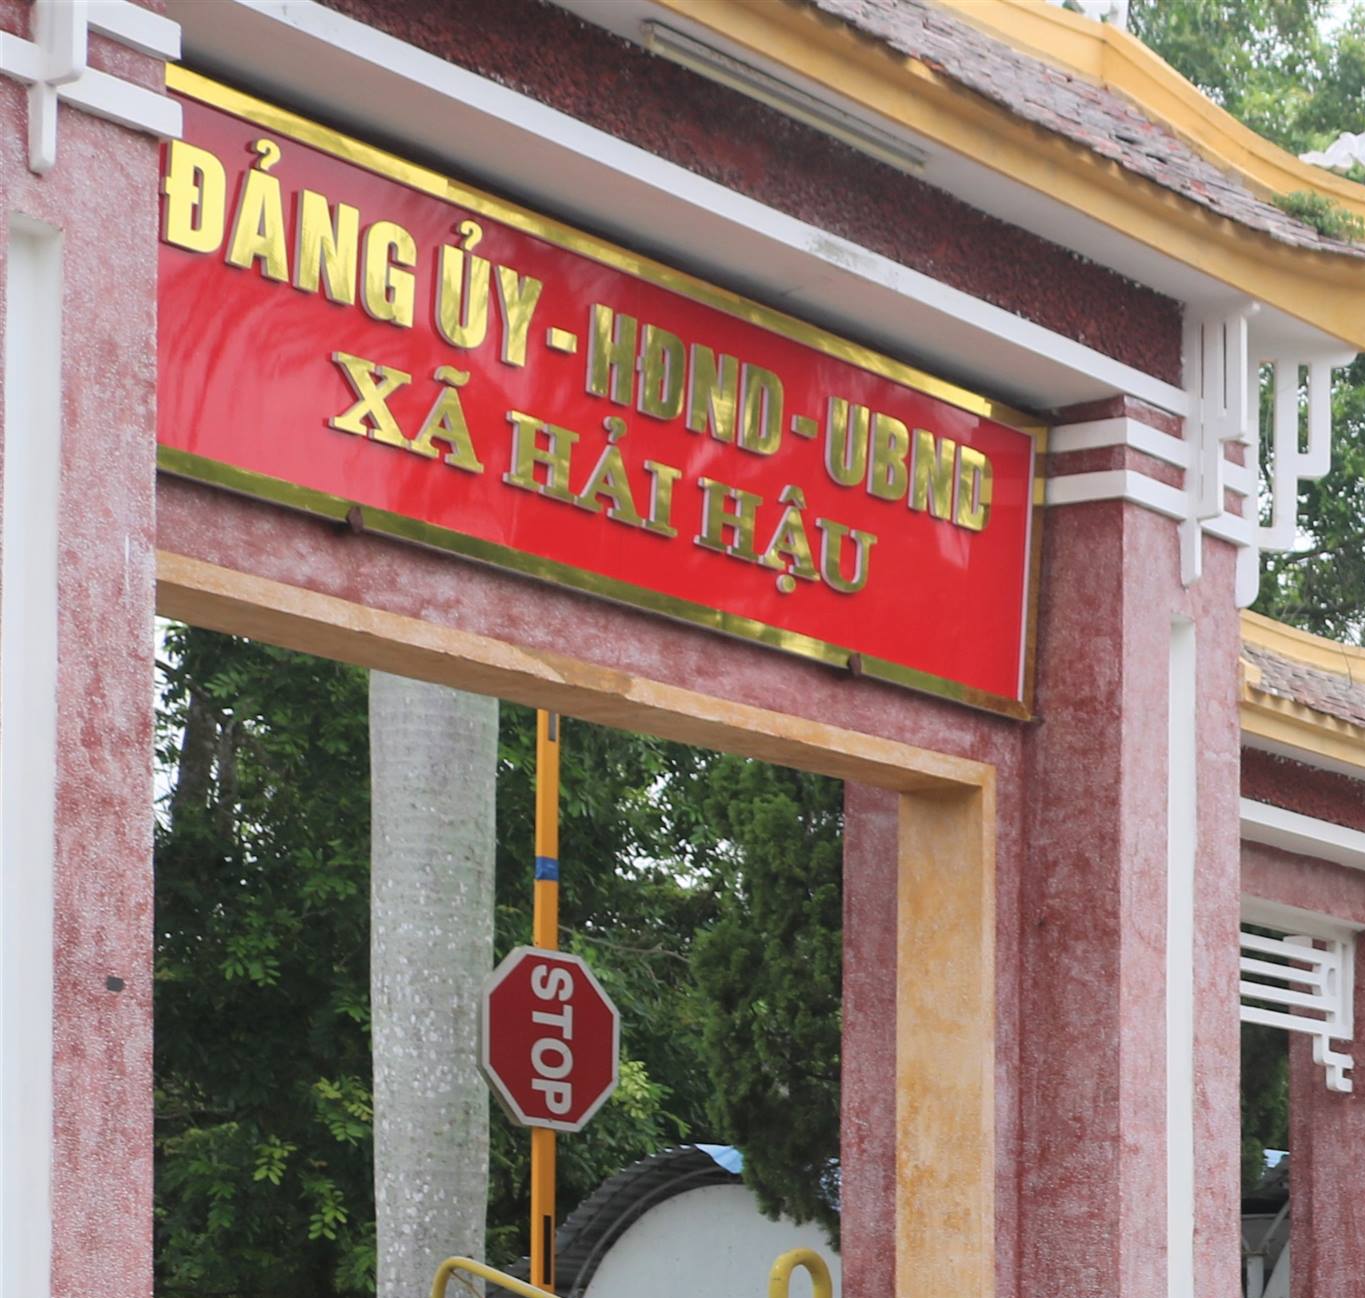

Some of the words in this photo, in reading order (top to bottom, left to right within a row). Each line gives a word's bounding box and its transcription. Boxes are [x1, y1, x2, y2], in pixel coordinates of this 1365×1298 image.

[161, 138, 418, 329] ĐẢNG
[585, 303, 784, 456] HĐND
[824, 395, 993, 532] UBND
[328, 350, 484, 474] XÃ
[502, 410, 682, 539] HẢI
[693, 476, 878, 594] HẬU
[530, 964, 575, 1116] STOP
